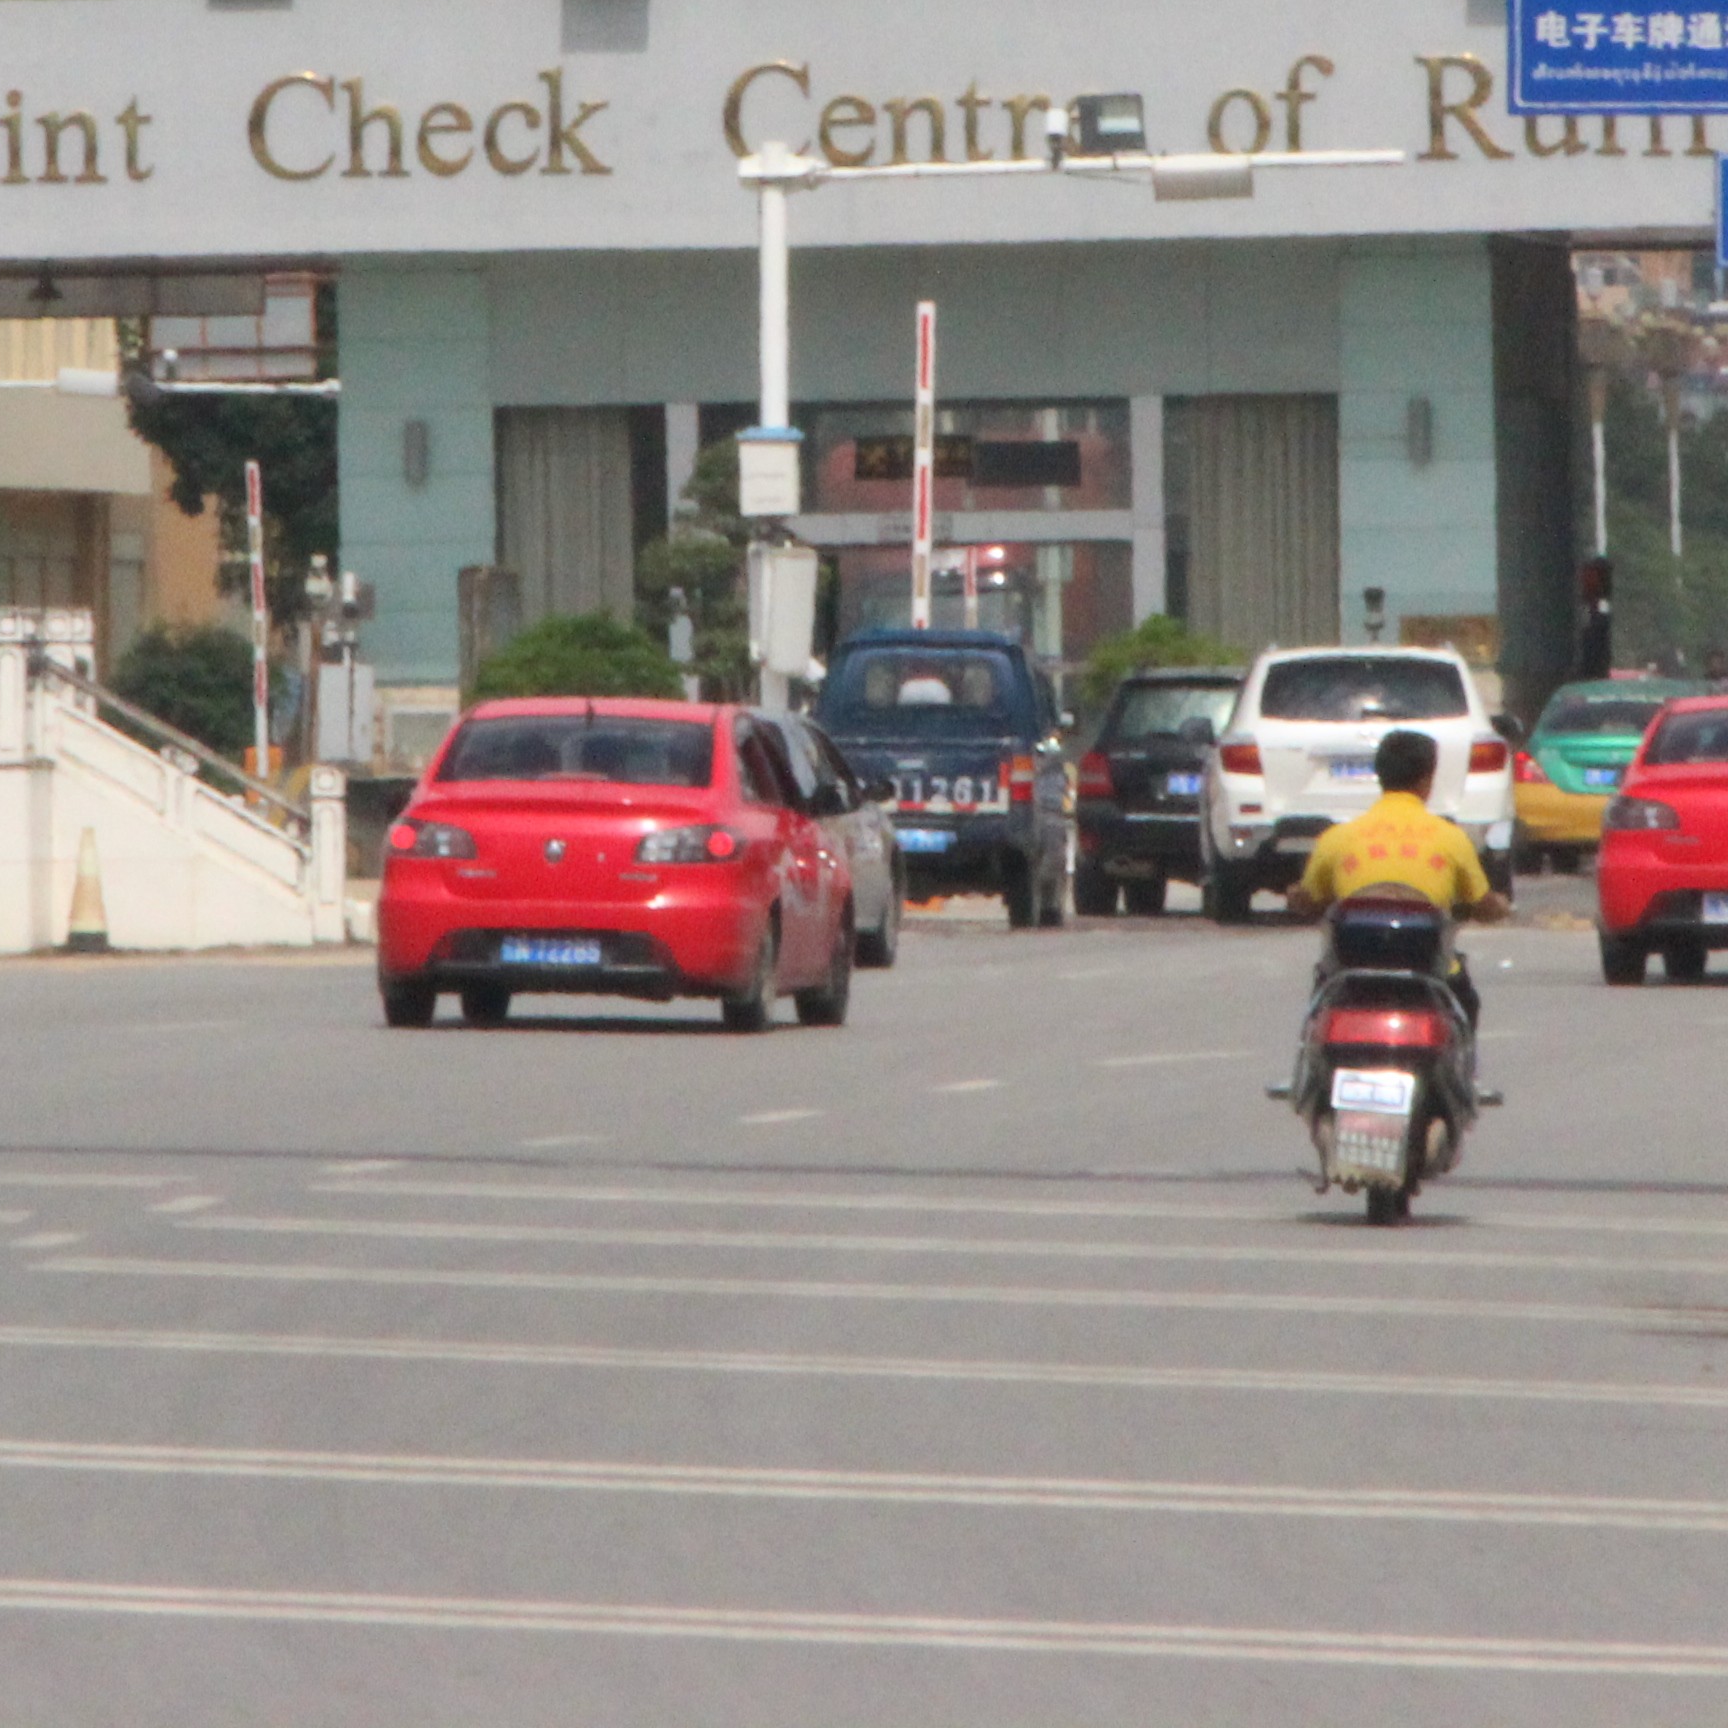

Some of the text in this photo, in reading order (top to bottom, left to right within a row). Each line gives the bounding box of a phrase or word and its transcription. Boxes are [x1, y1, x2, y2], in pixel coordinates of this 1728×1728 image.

[248, 65, 611, 183] Check
[723, 59, 1087, 167] Centr
[1208, 54, 1333, 154] of
